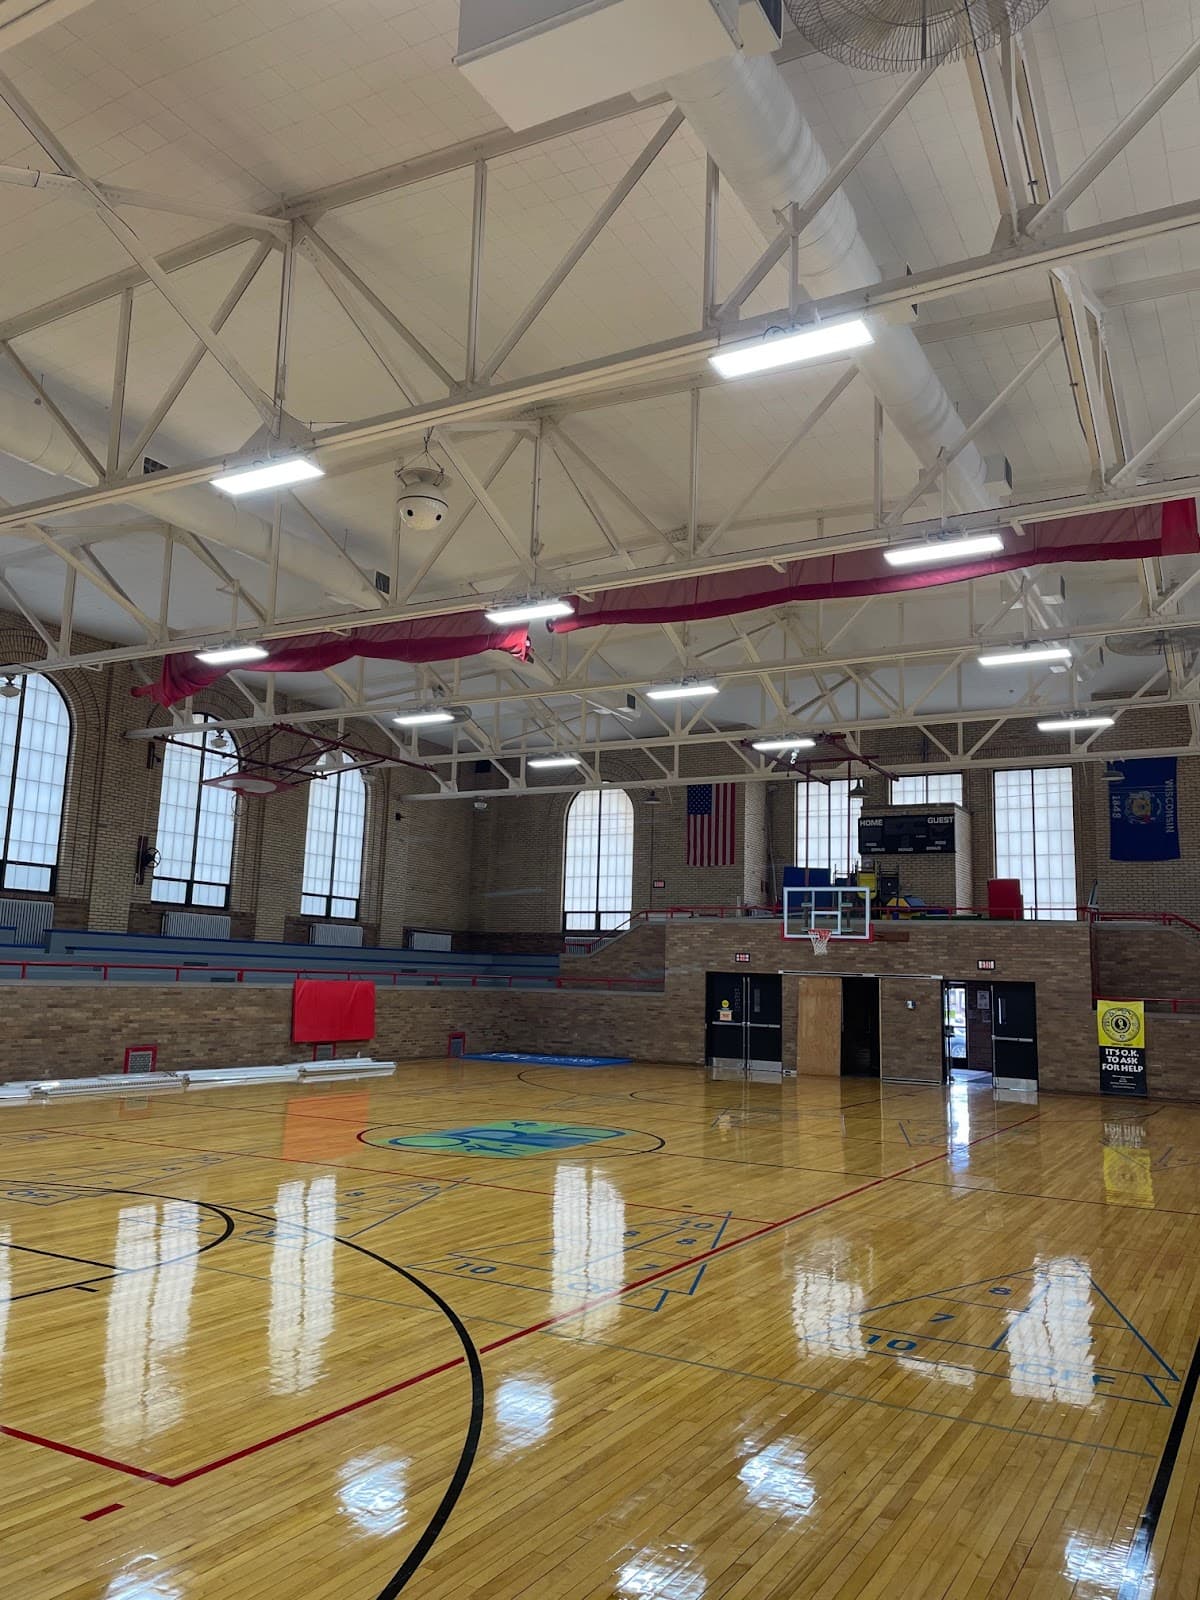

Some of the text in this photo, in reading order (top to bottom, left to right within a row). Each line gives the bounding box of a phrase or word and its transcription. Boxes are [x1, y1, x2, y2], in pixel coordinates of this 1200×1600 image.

[1112, 795, 1122, 819] 1848
[1165, 779, 1175, 833] WISCONSIN
[860, 819, 884, 827] HOME
[927, 816, 954, 824] GUEST
[1102, 1063, 1143, 1072] FOR HELP
[675, 1238, 698, 1246] 8
[453, 1262, 497, 1275] 10
[988, 1287, 1012, 1296] 8
[928, 1312, 957, 1324] 7
[863, 1334, 918, 1351] 10
